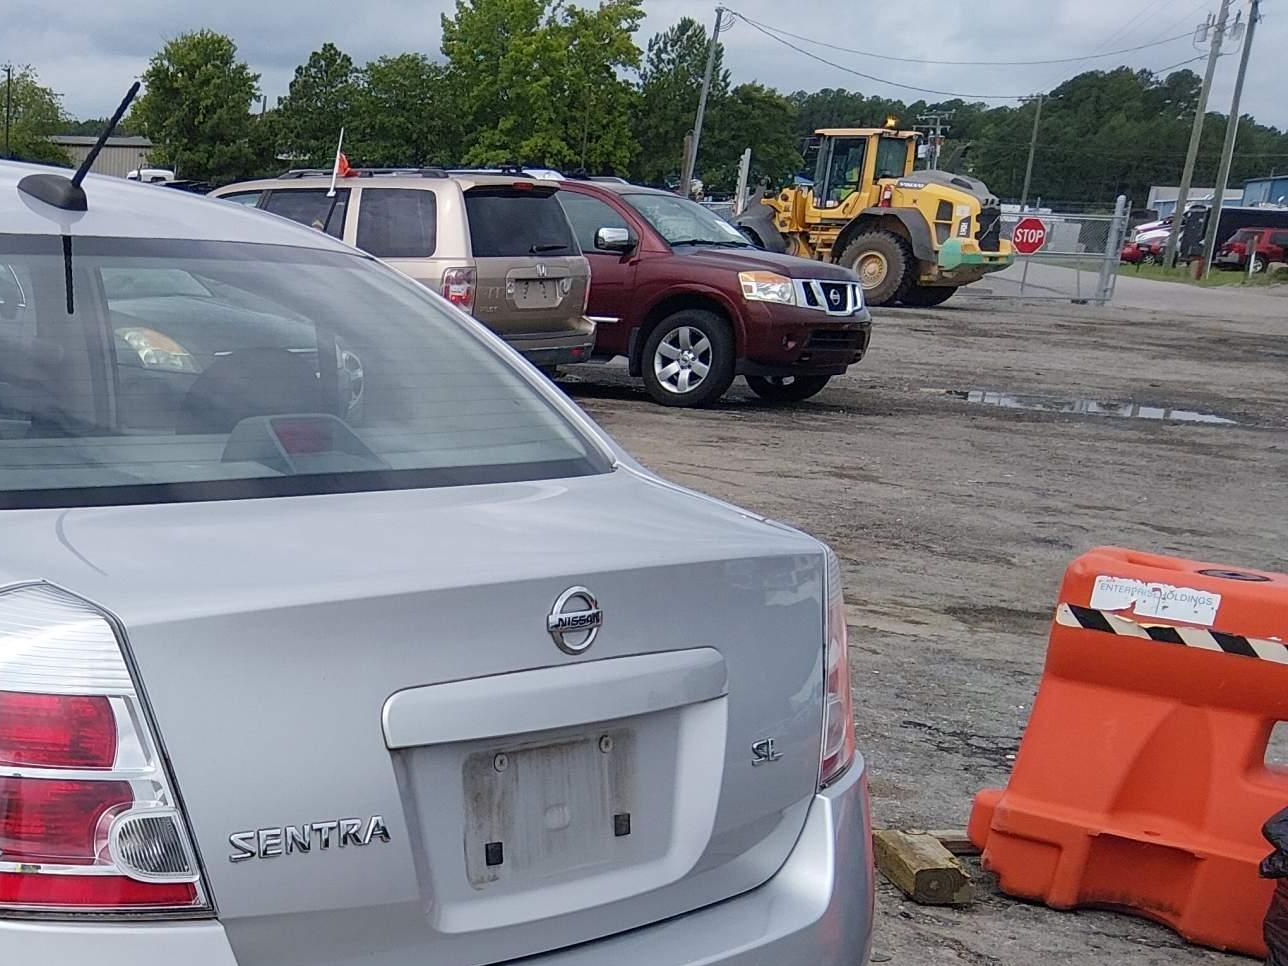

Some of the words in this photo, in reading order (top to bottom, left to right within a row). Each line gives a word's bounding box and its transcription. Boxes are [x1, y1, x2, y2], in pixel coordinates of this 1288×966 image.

[1015, 228, 1044, 244] STOP
[1100, 582, 1162, 599] ENTERPRISE
[558, 611, 600, 627] NISSAN
[752, 738, 784, 766] SL
[228, 814, 392, 863] SENTRA
